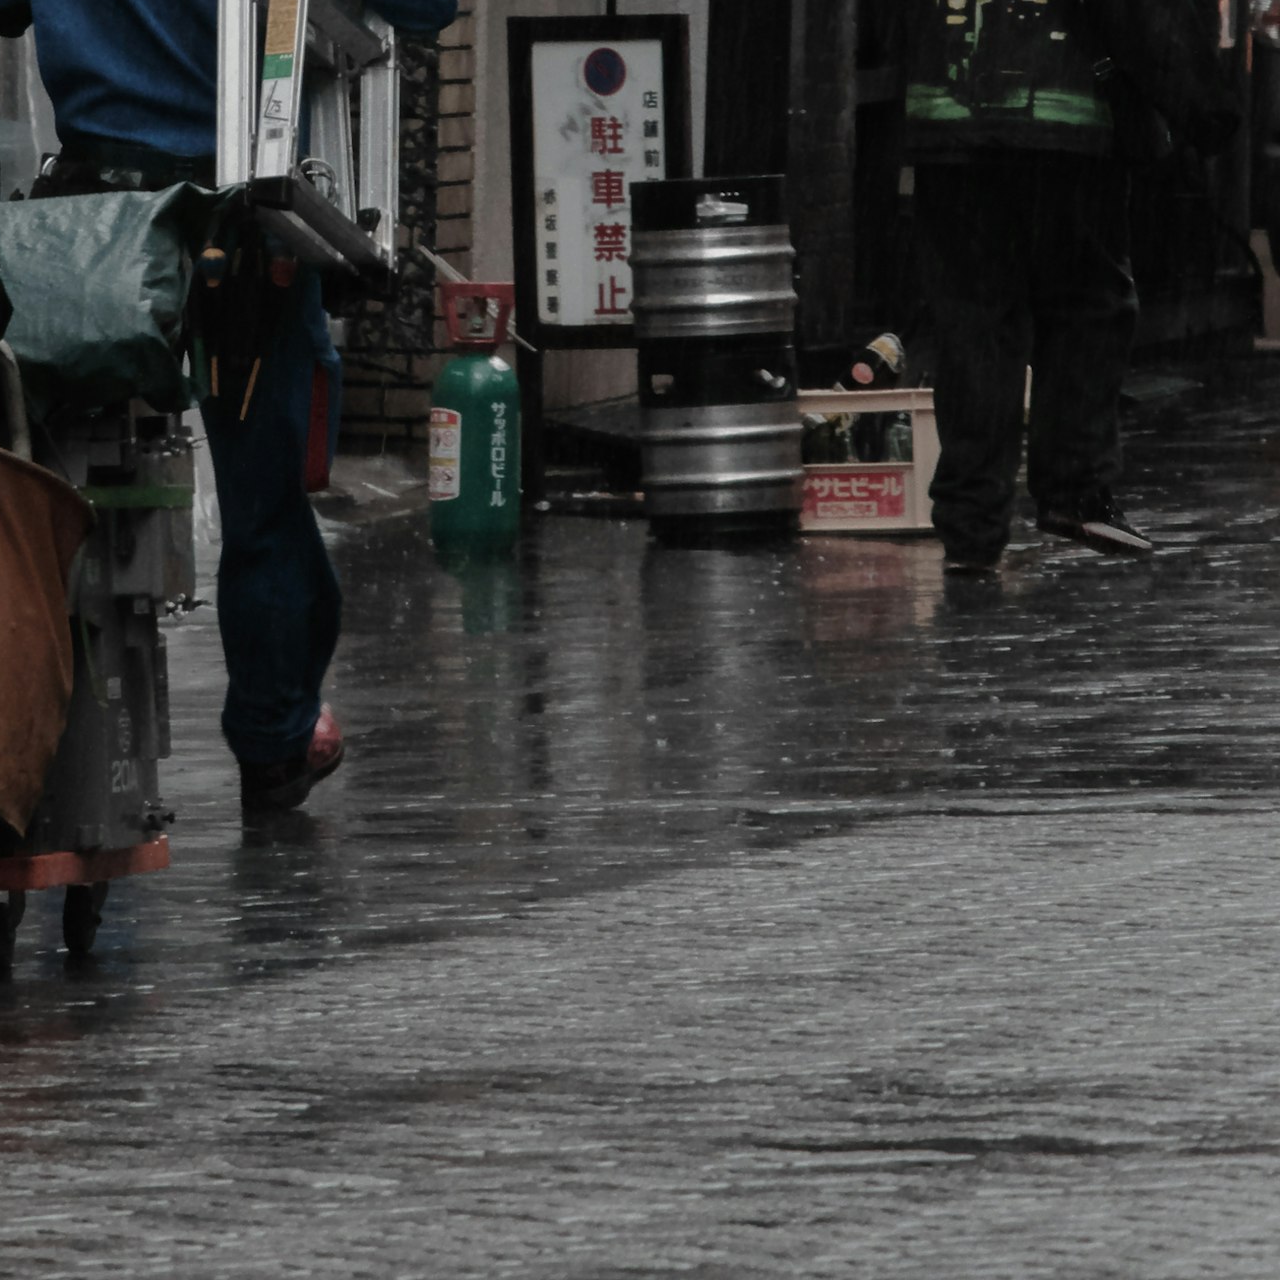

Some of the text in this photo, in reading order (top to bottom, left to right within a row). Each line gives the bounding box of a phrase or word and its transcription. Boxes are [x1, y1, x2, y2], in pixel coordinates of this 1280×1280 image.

[641, 90, 661, 182] 店舗前
[589, 115, 629, 317] 駐車禁止
[490, 401, 507, 508] サッポロビール
